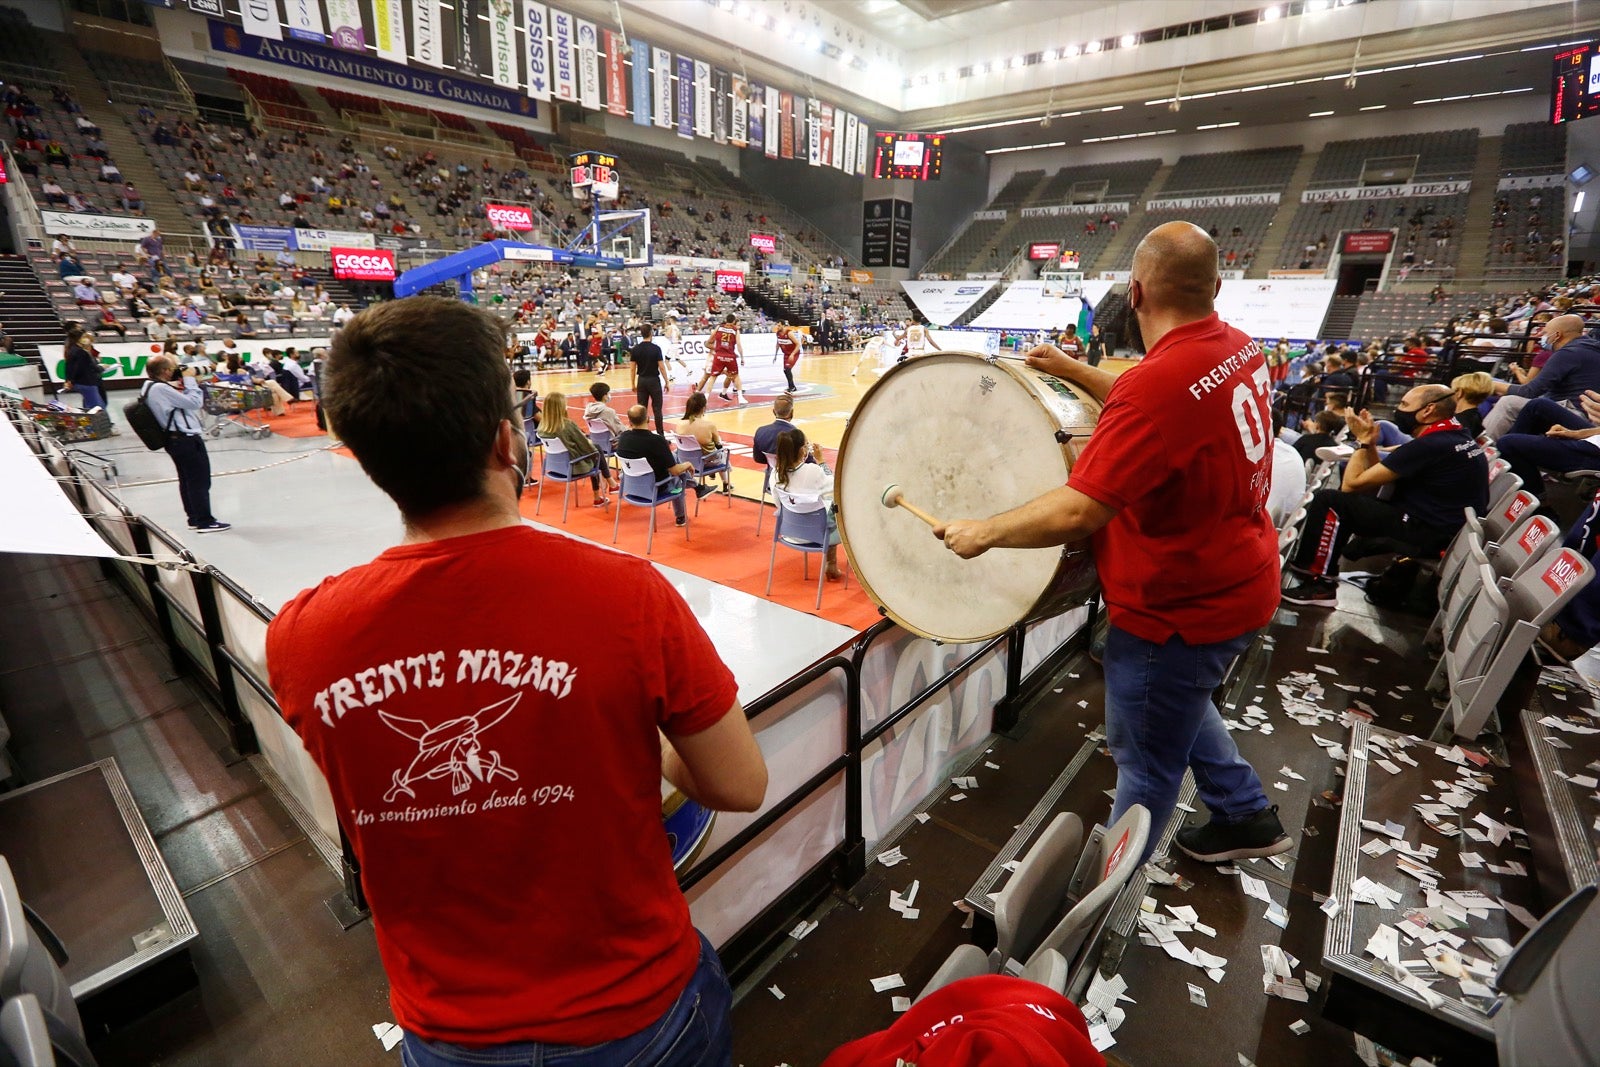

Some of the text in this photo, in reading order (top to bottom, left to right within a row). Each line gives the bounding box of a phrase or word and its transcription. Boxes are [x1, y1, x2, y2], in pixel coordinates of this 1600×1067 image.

[529, 8, 544, 75] asisa
[556, 14, 571, 81] BERNER
[257, 38, 511, 110] AYUNTAMIENTO DE GRANADA
[585, 48, 596, 93] Cuerva
[734, 108, 746, 140] enPie
[1150, 195, 1273, 210] IDEAL IDEAL IDEAL
[1306, 182, 1470, 201] IDEAL IDEAL IDEAL
[1024, 203, 1127, 217] IDEAL IDEAL IDEAL
[1188, 340, 1262, 400] FRENTE NAZA
[1511, 498, 1523, 513] NO
[1527, 524, 1540, 540] NO
[1552, 558, 1571, 578] NO
[314, 650, 446, 728] FRENTE
[379, 801, 477, 823] sentimiento
[481, 786, 527, 811] desde
[531, 784, 575, 806] 1994
